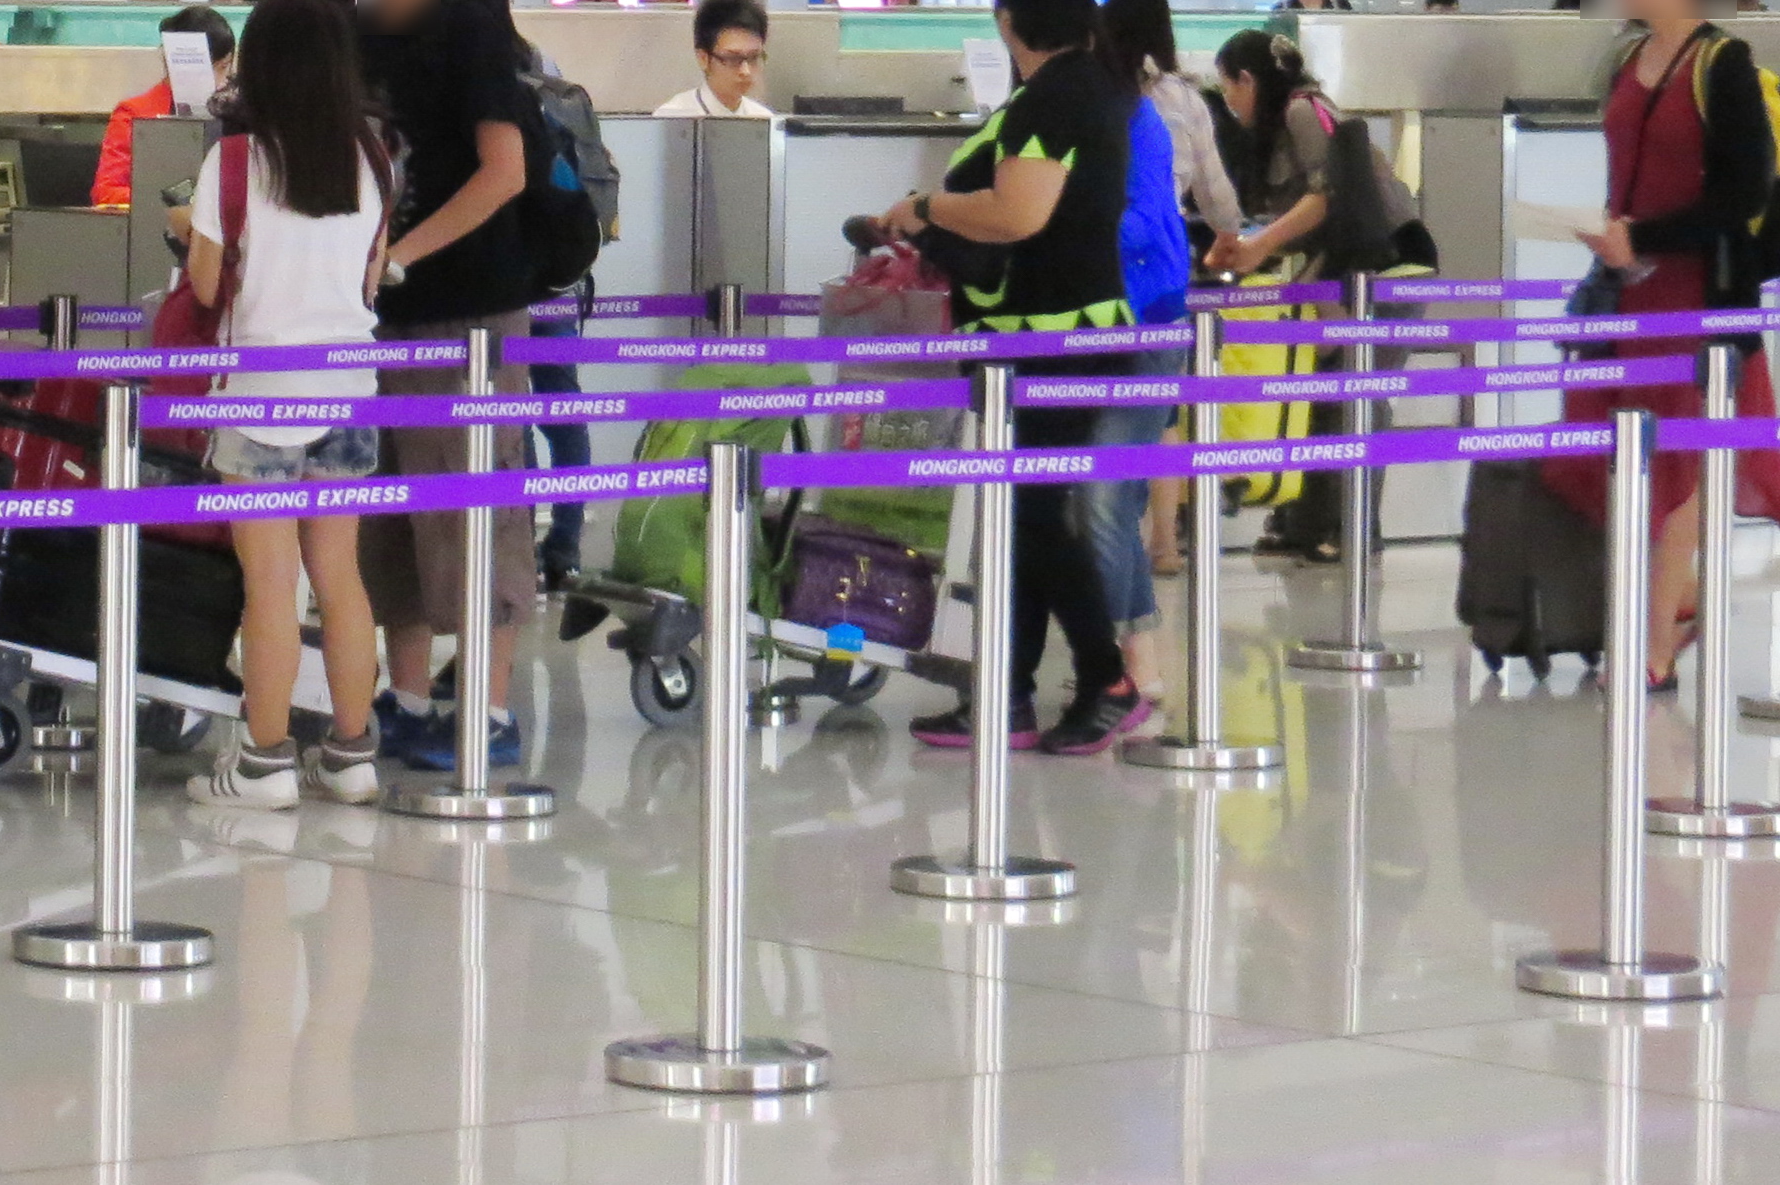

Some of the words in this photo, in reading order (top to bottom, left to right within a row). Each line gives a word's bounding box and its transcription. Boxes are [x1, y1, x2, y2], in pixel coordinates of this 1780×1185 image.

[583, 300, 640, 313] XPRESS
[1063, 331, 1135, 347] HONGKONG
[1140, 328, 1193, 344] EXPRES
[1323, 325, 1389, 338] HONGKONG
[1394, 325, 1449, 338] EXPRESS
[1516, 322, 1580, 337] HONGKONG
[1583, 320, 1638, 334] EXPRESS
[326, 348, 408, 364] HONGKONG
[413, 345, 467, 361] EXPRE
[617, 344, 696, 358] HONGKONG
[701, 343, 766, 357] EXPRESS
[846, 341, 921, 356] HONGKONG
[926, 339, 989, 353] EXPRESS
[77, 355, 163, 371] HONGKONG
[168, 352, 239, 368] EXPRESS
[1485, 370, 1558, 386] HONGKONG
[1563, 366, 1625, 382] EXPRESS
[1026, 384, 1107, 399] HONGKONG
[1113, 382, 1180, 398] EXPRESS
[1262, 379, 1339, 396] HONGKONG
[1344, 377, 1408, 392] EXPRESS
[451, 401, 544, 417] HONGKONG
[550, 399, 627, 415] EXPRESS
[720, 393, 807, 410] HONGKONG
[813, 390, 886, 407] EXPRESS
[168, 403, 265, 420] HONGKONG
[272, 402, 352, 420] EXPRESS
[1458, 434, 1544, 452] HONGKONG
[1550, 429, 1613, 448] EXPRES
[1192, 447, 1284, 467] HONGKONG
[1290, 442, 1366, 462] EXPRESS
[908, 458, 1005, 477] HONGKONG
[1013, 455, 1094, 474] EXPRESS
[523, 472, 628, 495] HONGKONG
[196, 490, 309, 513] HONGKONG
[316, 485, 409, 507] EXPRESS
